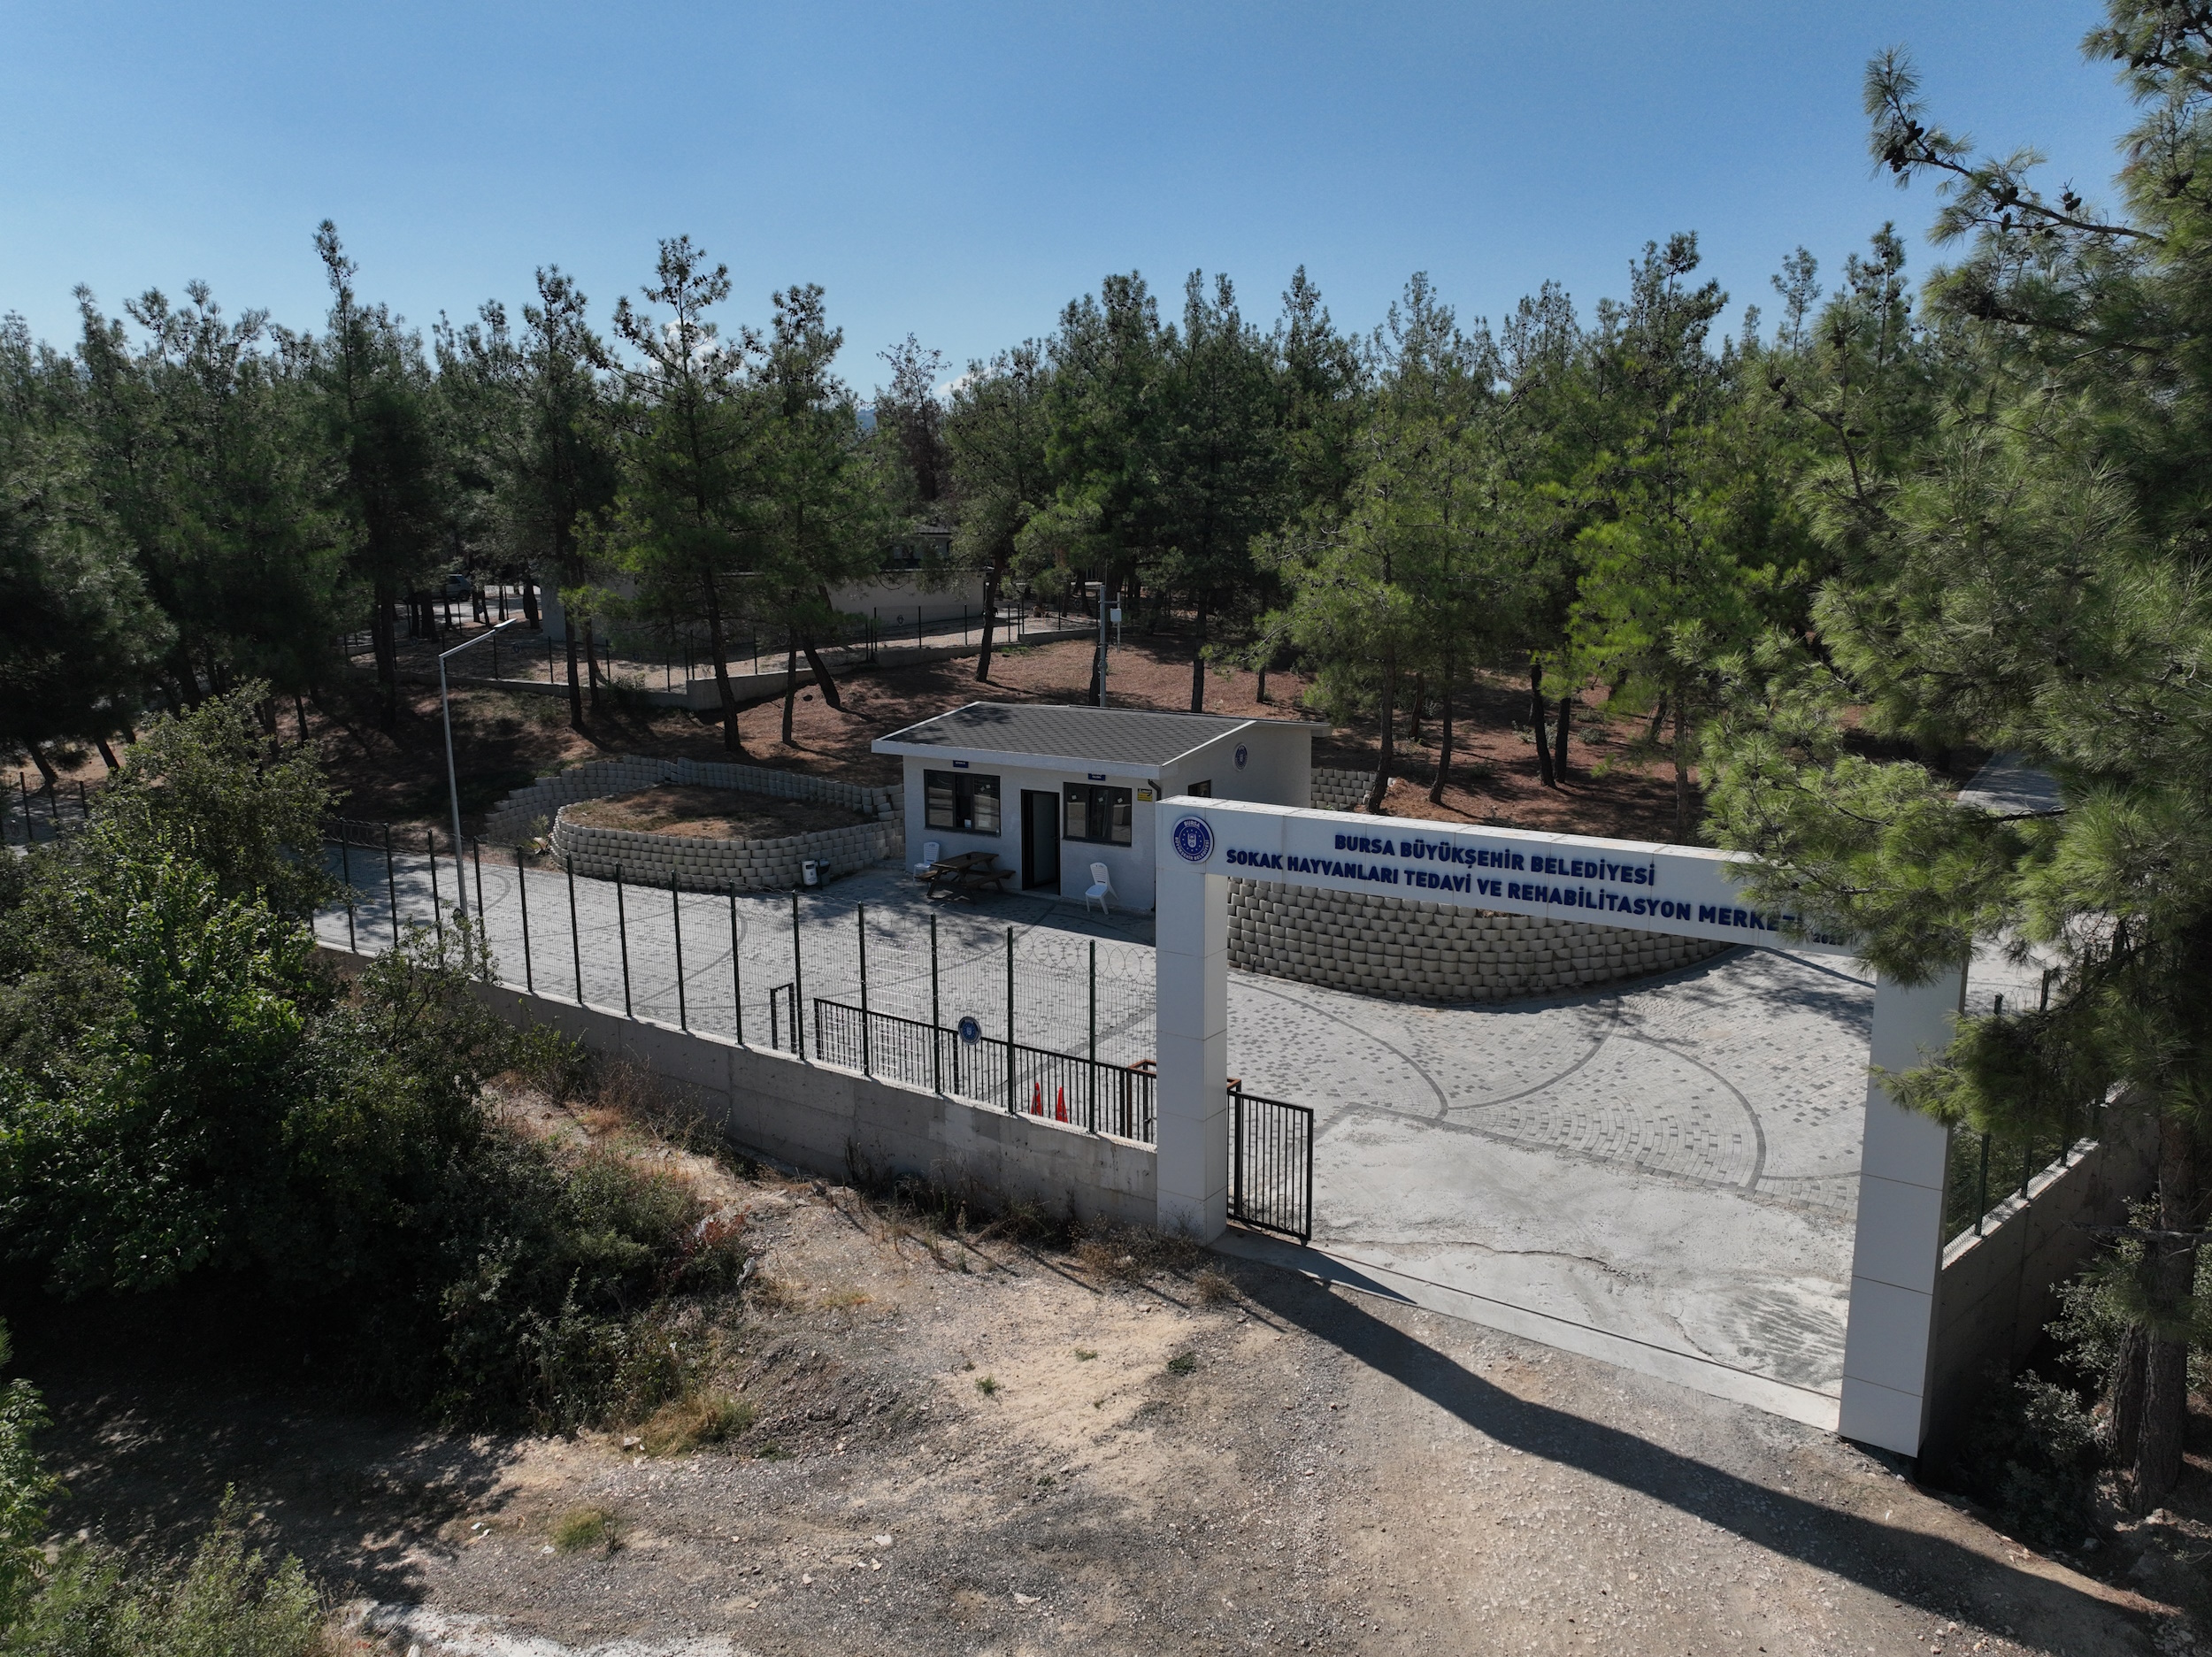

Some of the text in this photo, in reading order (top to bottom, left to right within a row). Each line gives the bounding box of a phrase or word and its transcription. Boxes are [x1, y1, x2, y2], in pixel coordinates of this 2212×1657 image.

[1183, 819, 1201, 828] BURSA
[1225, 848, 1282, 871] SOKAK
[1286, 855, 1399, 885] HAYVANLARI
[1403, 869, 1471, 894] TEDAVİ
[1476, 878, 1502, 897] VE
[1508, 882, 1692, 922] REHABİLİTASYON
[1334, 834, 1655, 886] BURSA BÜYÜKŞEHİR BELEDİYESİ
